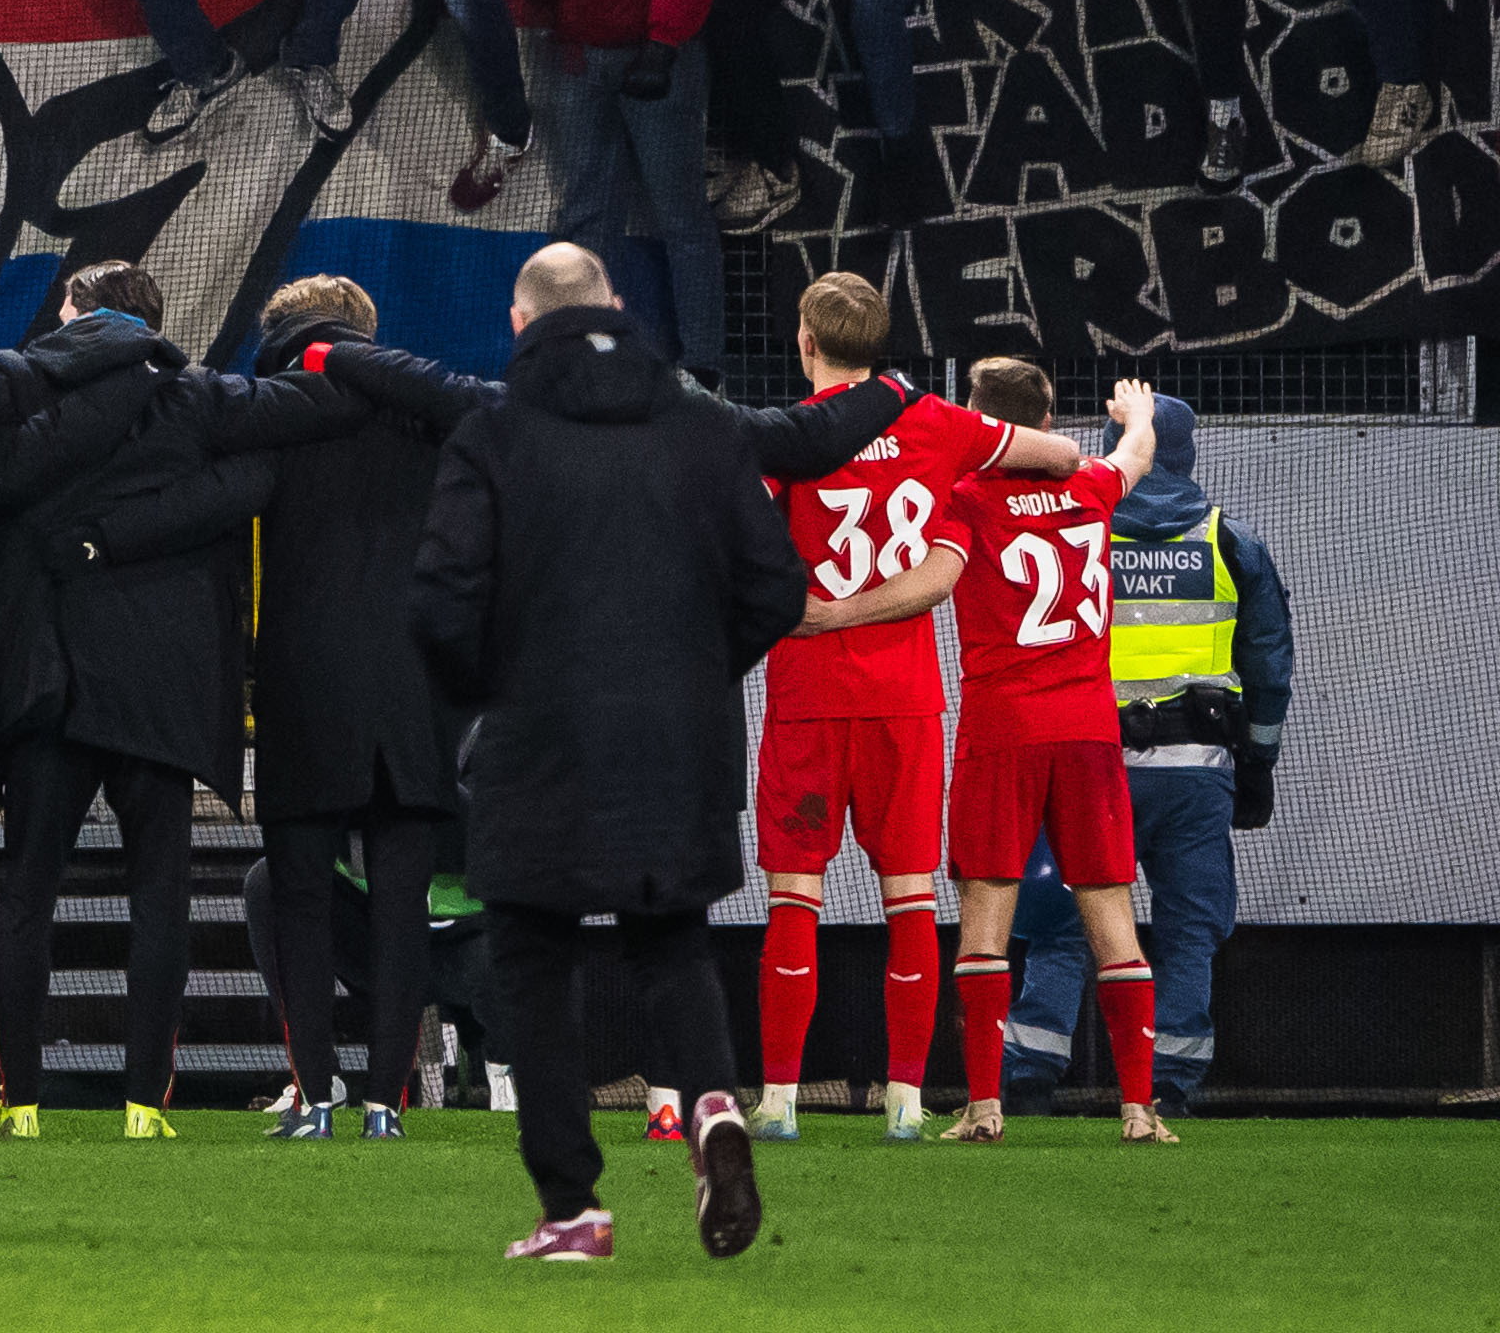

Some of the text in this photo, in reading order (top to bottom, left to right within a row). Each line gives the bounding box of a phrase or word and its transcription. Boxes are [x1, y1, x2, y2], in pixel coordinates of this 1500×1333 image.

[814, 478, 936, 601] 38
[1108, 549, 1204, 572] RDNINGS
[999, 521, 1111, 648] 23
[1121, 575, 1177, 595] VAKT
